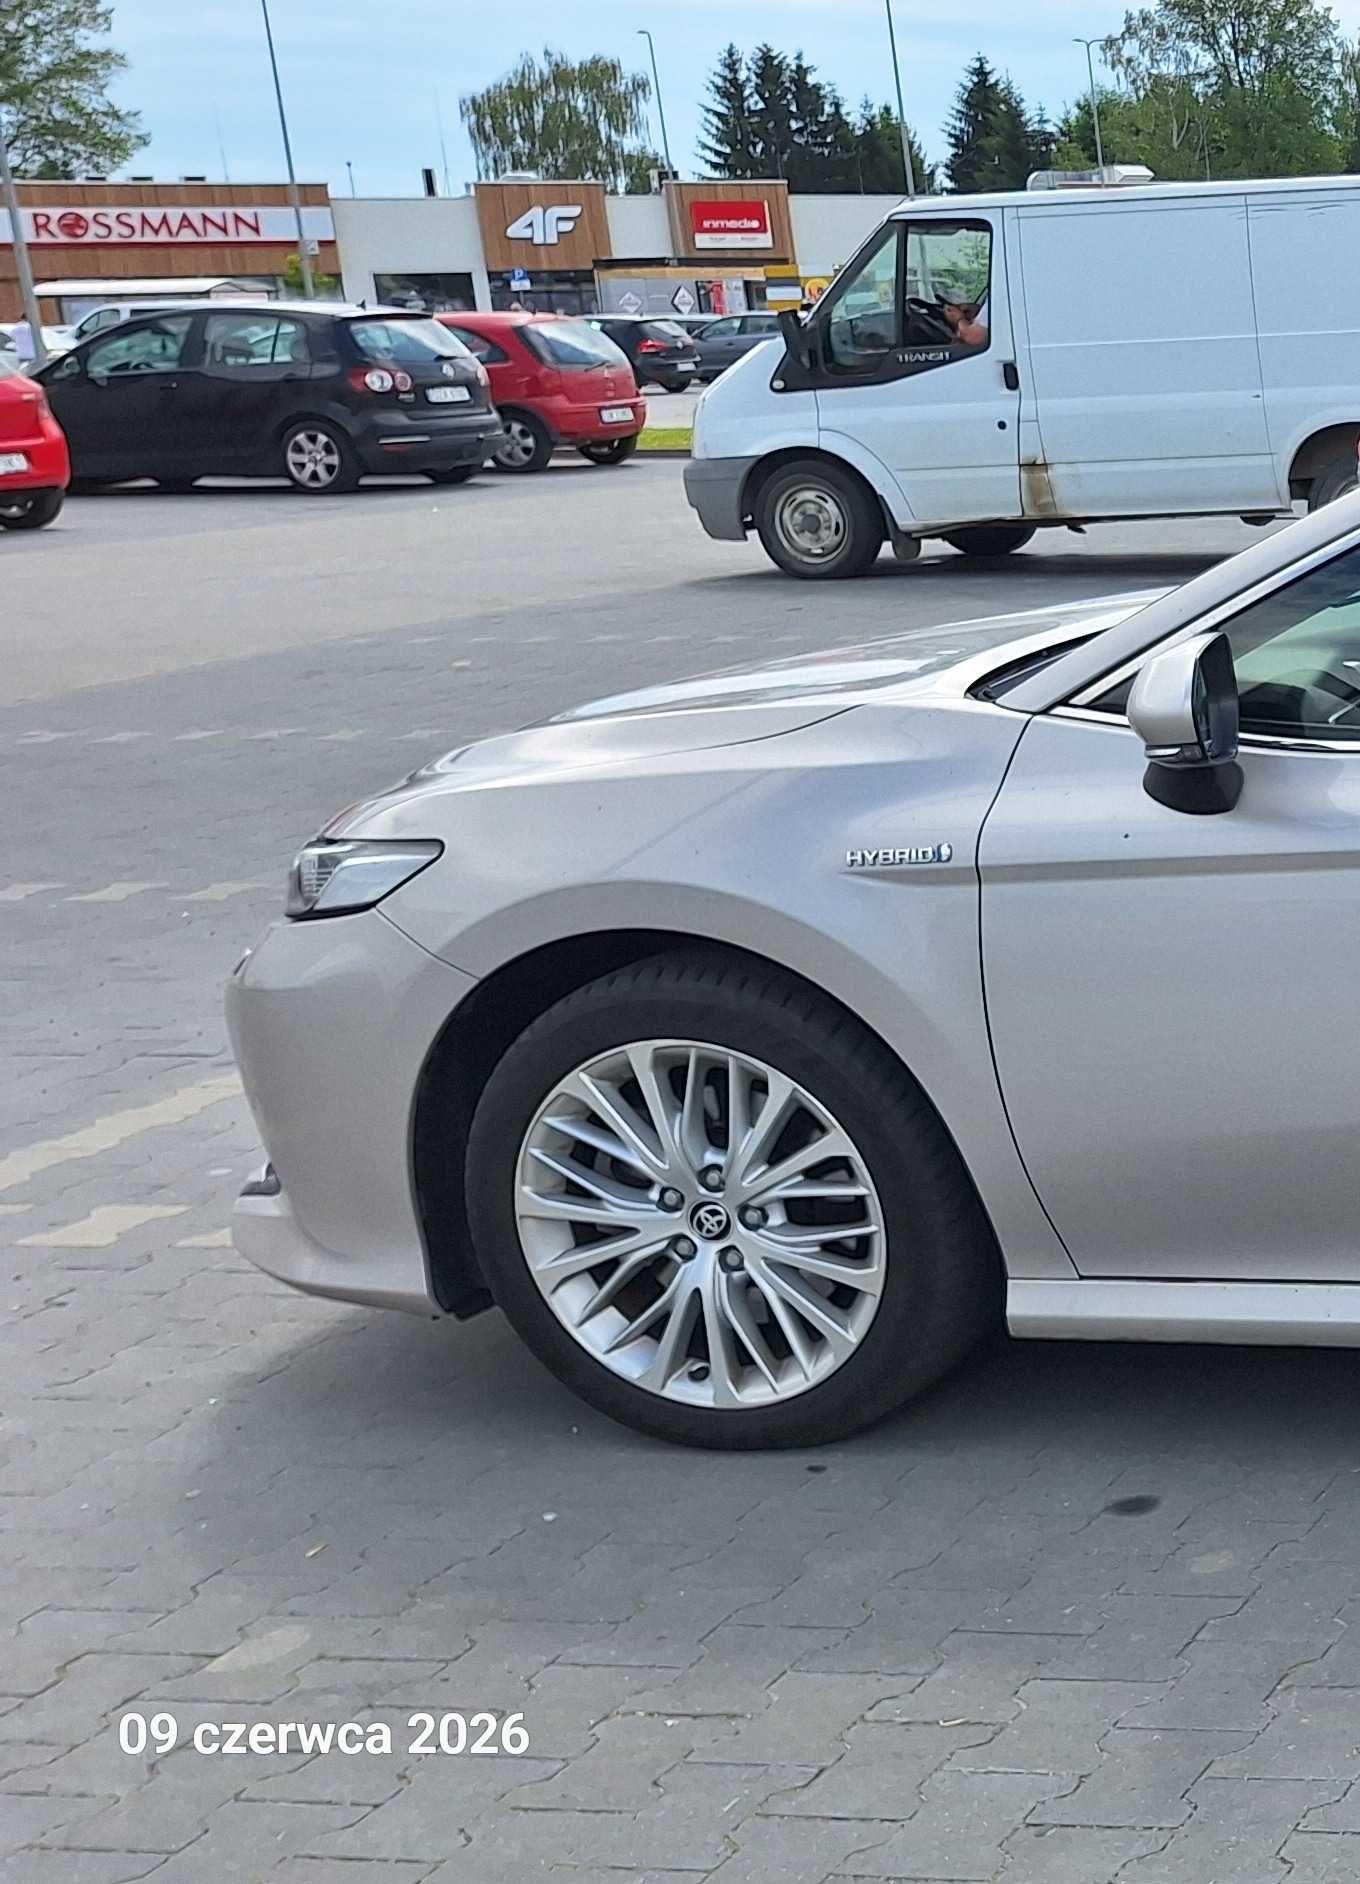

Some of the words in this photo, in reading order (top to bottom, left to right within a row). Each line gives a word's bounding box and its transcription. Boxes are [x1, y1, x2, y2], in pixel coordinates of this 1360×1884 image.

[32, 211, 263, 240] ROSSMANN
[505, 204, 584, 245] 4F
[897, 351, 951, 363] TRANSIT
[846, 847, 933, 866] HYBRID
